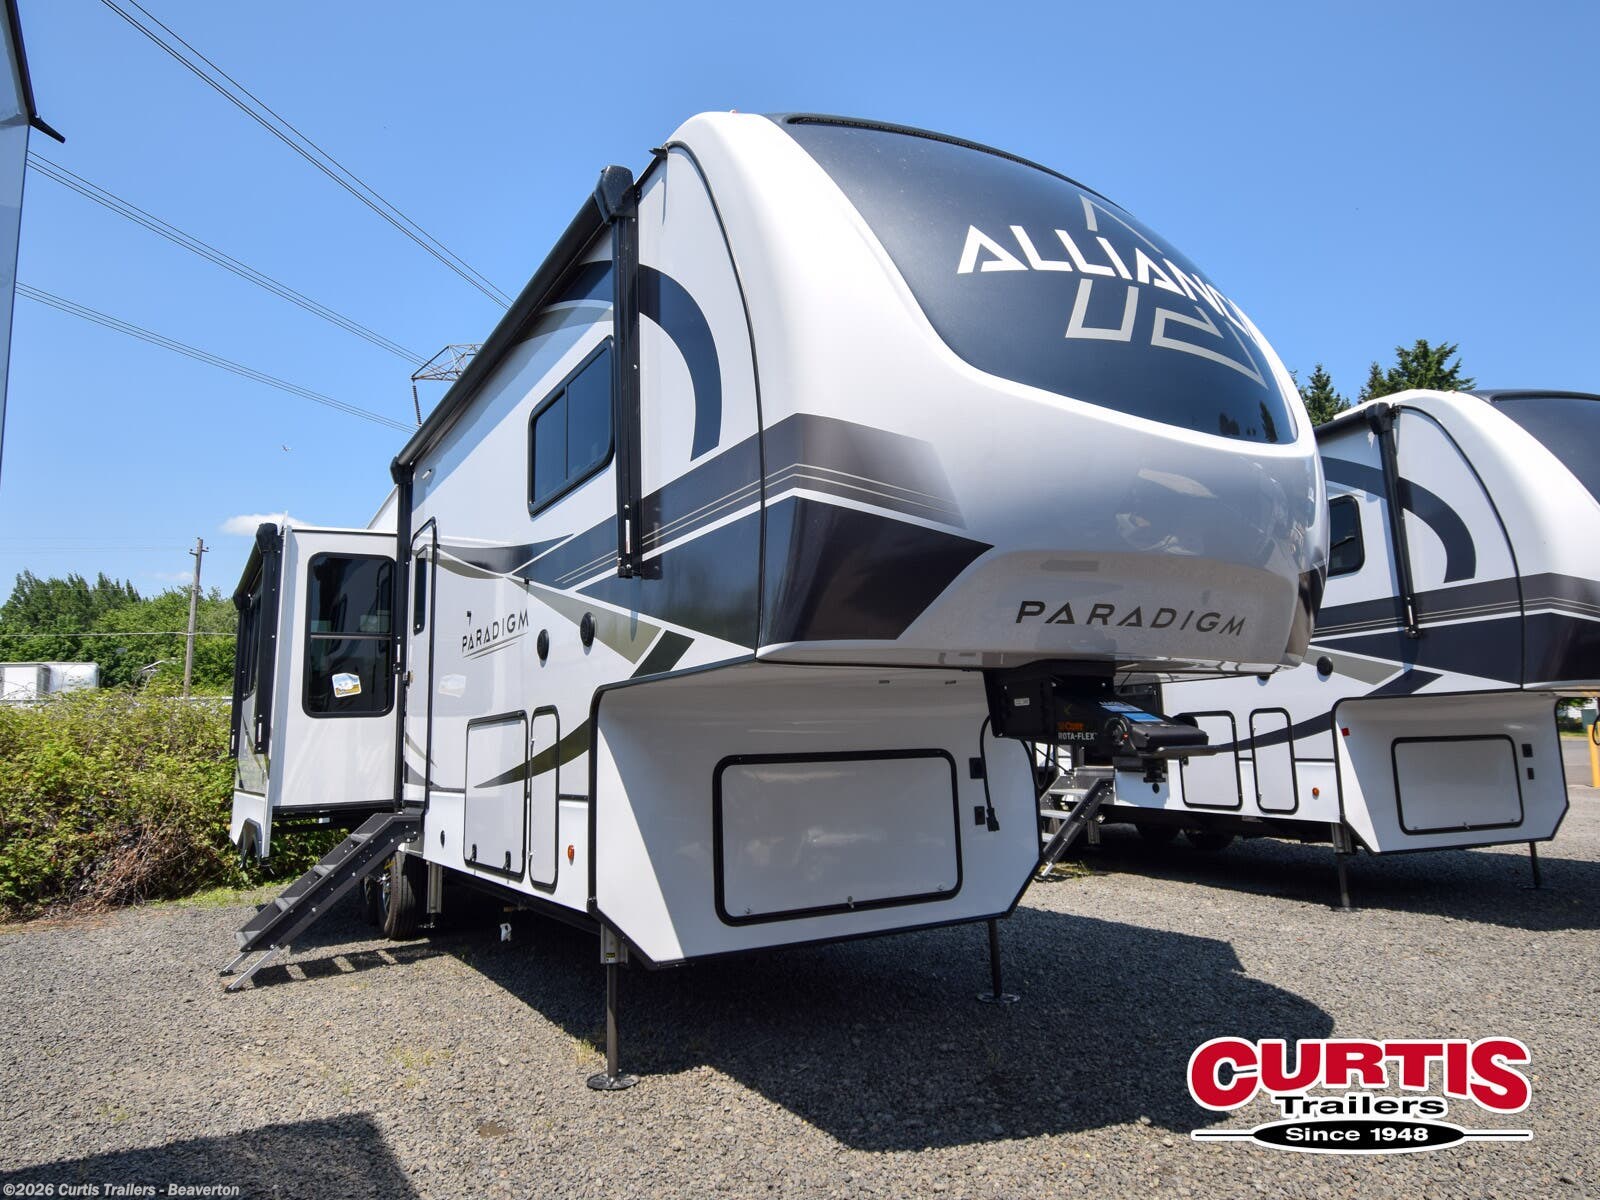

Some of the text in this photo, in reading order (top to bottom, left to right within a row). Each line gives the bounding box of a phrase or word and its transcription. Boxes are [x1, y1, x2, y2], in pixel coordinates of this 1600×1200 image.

[957, 224, 1251, 337] ALLIANC
[462, 608, 529, 653] PARADIGM
[1016, 600, 1246, 636] PARADIGM
